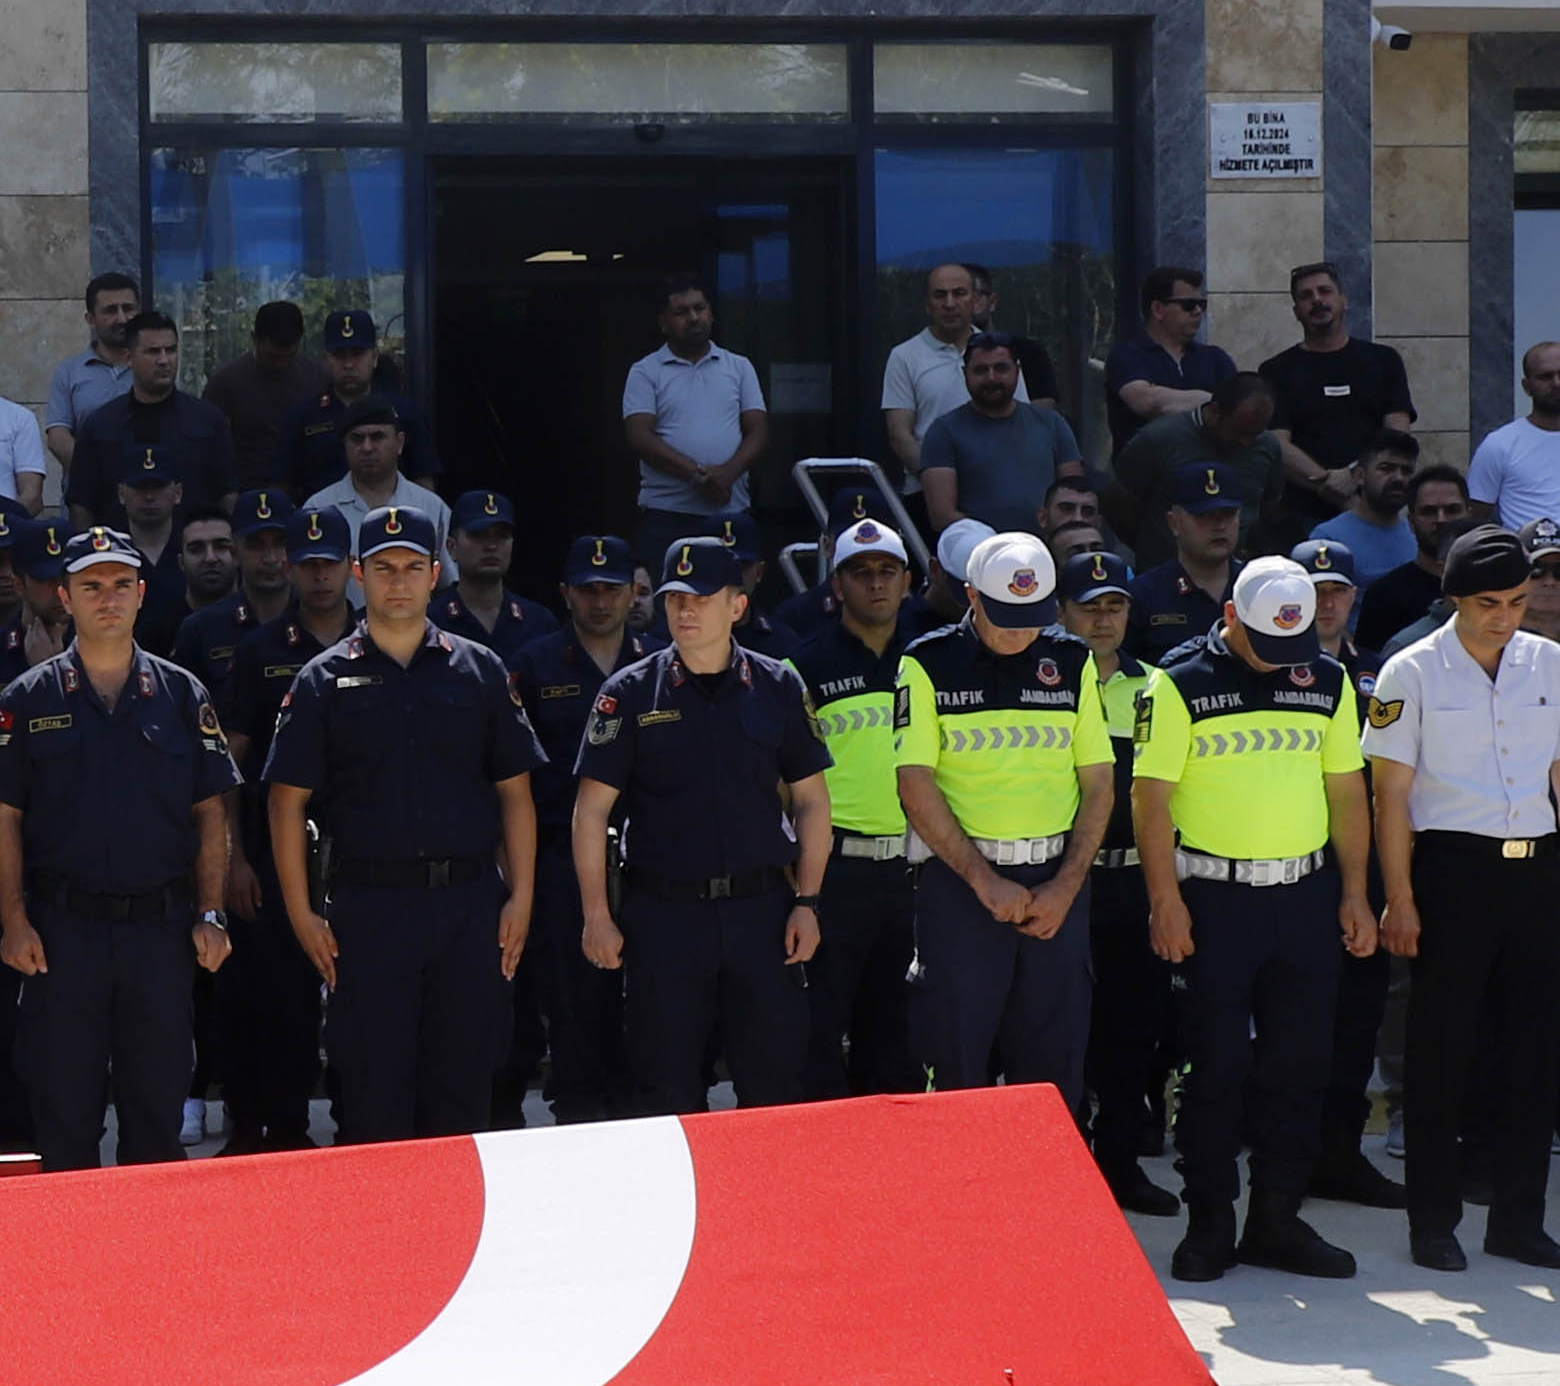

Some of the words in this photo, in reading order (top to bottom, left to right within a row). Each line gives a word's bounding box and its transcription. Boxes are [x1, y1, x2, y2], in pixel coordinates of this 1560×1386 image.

[1247, 112, 1261, 124] BU
[1263, 110, 1285, 124] BİNA
[1242, 142, 1291, 156] TARİHİNDE
[1219, 158, 1260, 172] HİZMETE
[1262, 158, 1314, 174] AÇILMIŞTIR
